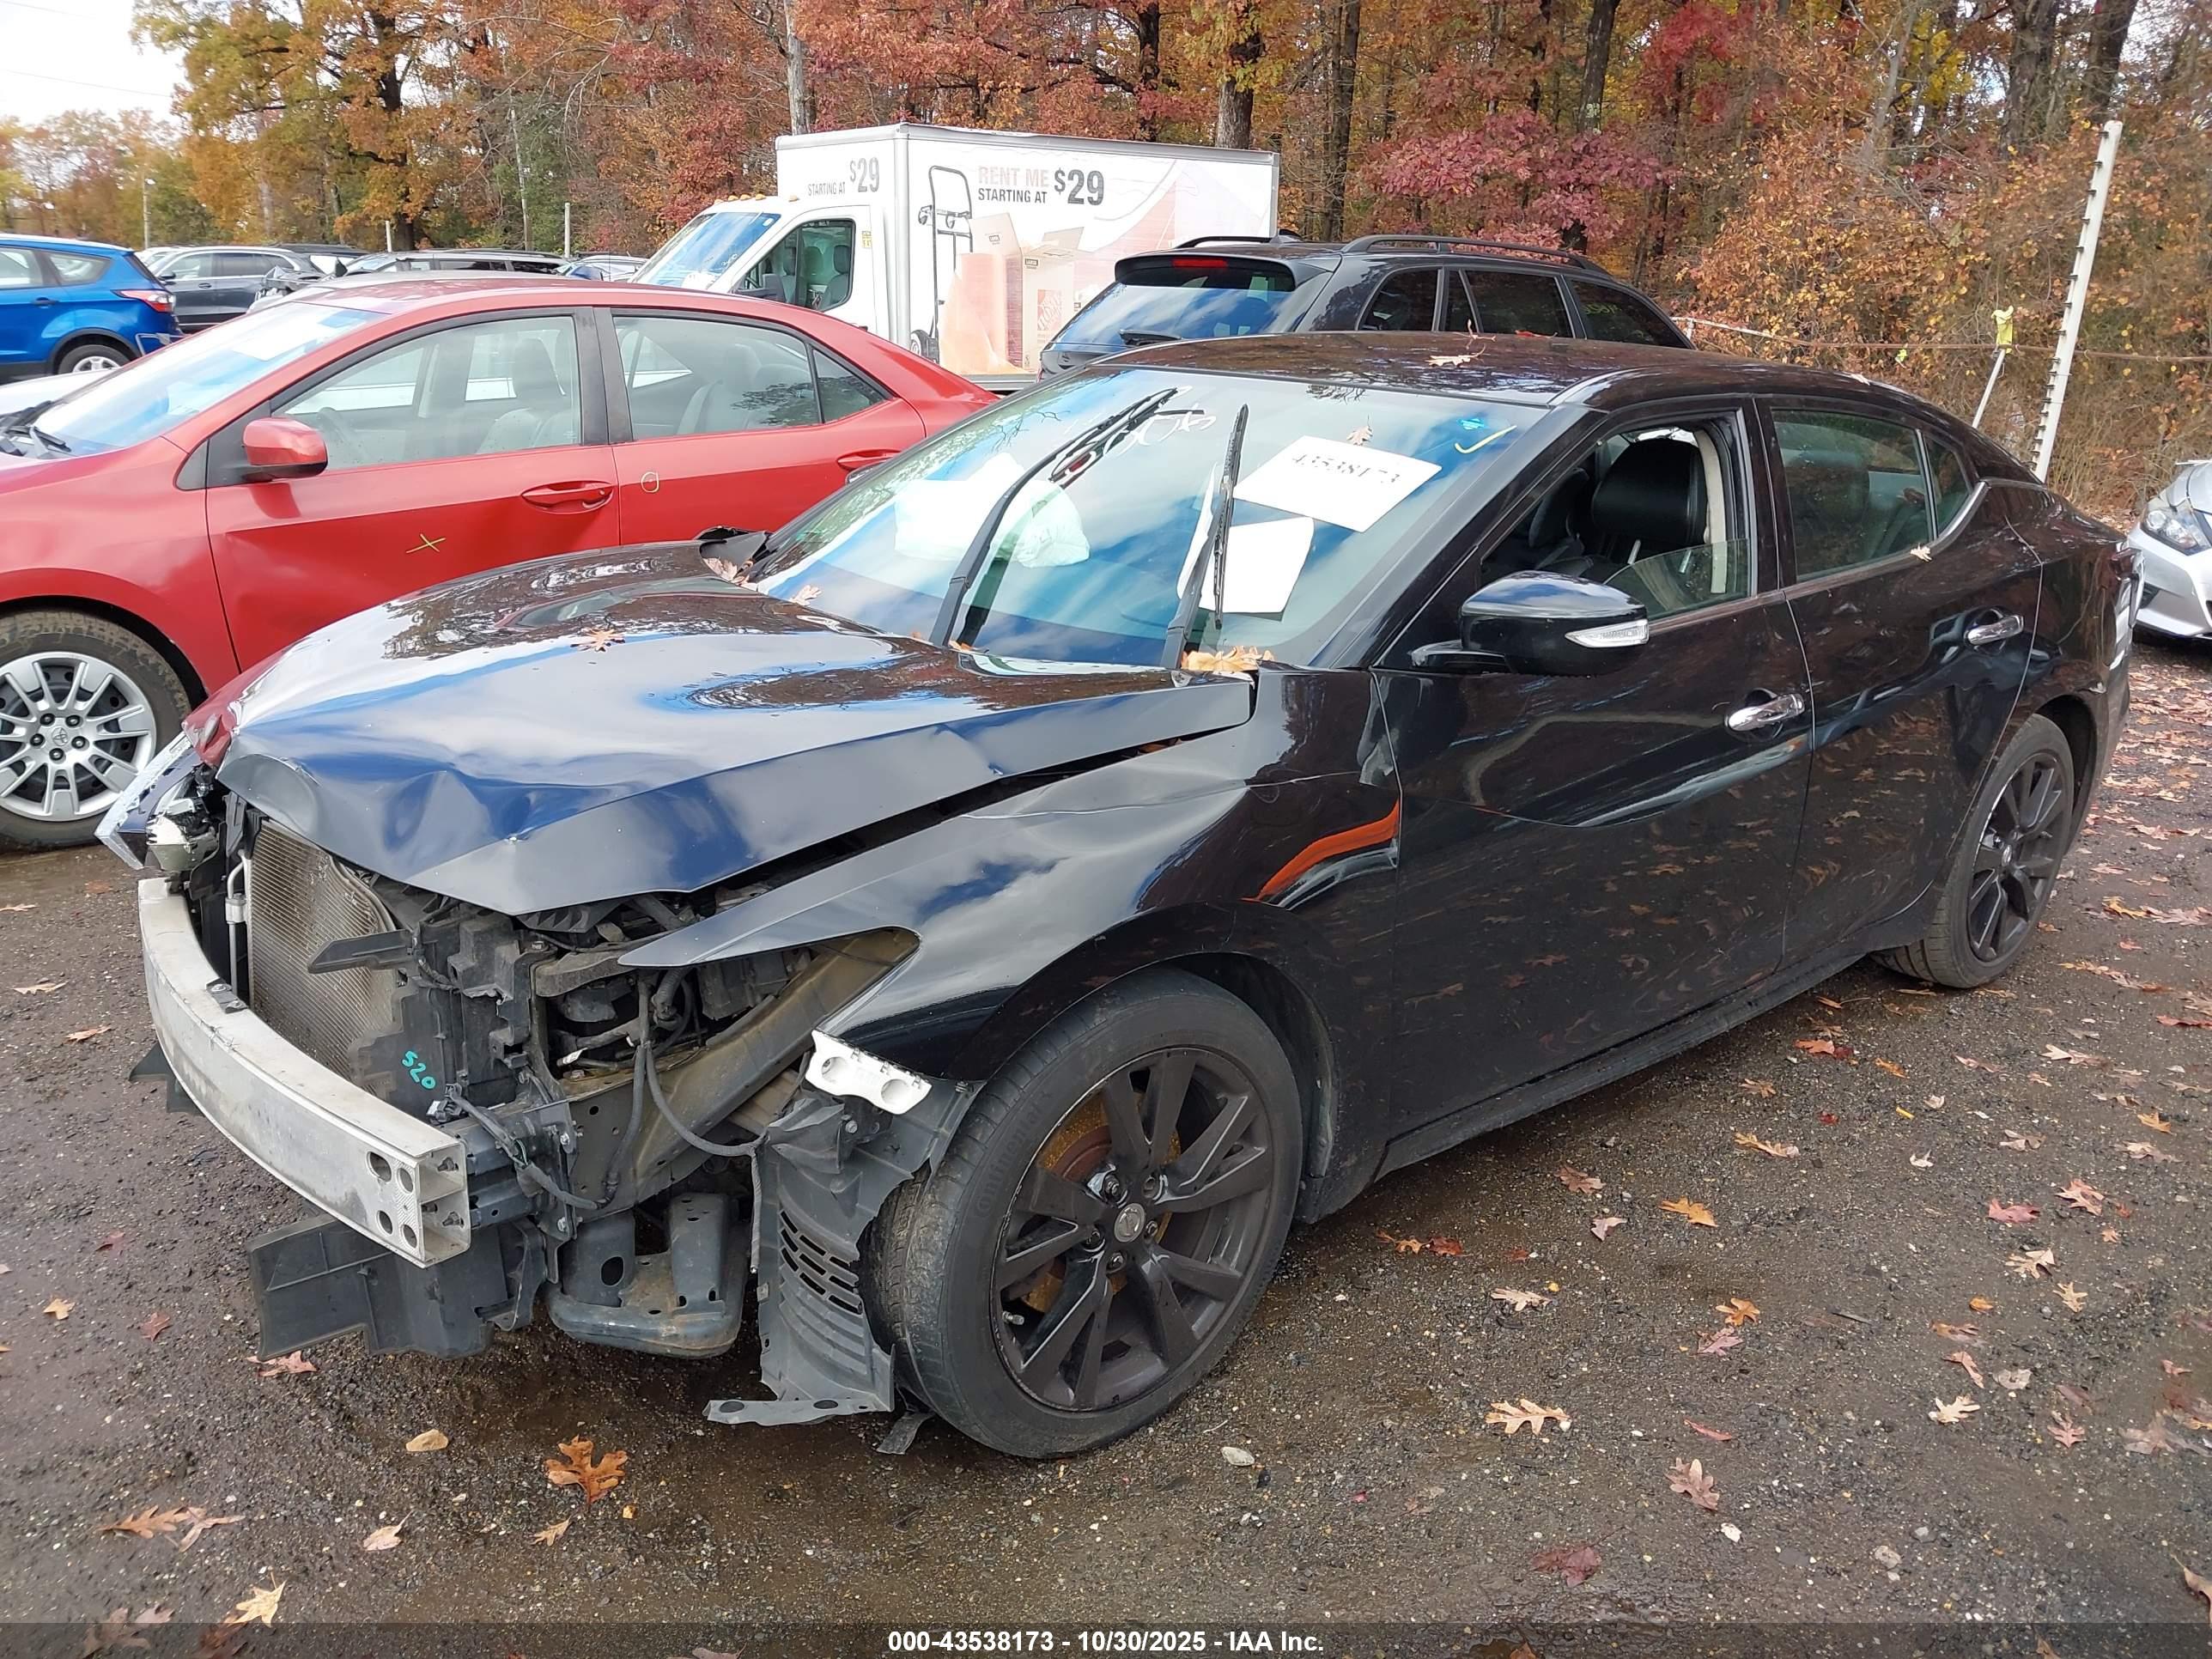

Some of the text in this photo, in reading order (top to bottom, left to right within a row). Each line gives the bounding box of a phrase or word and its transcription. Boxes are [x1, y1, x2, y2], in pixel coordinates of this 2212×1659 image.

[807, 156, 880, 196] STARTING AT $29
[977, 167, 1104, 206] STARTING AT $29
[978, 166, 1049, 187] RENT ME
[975, 1101, 1042, 1218] Continental
